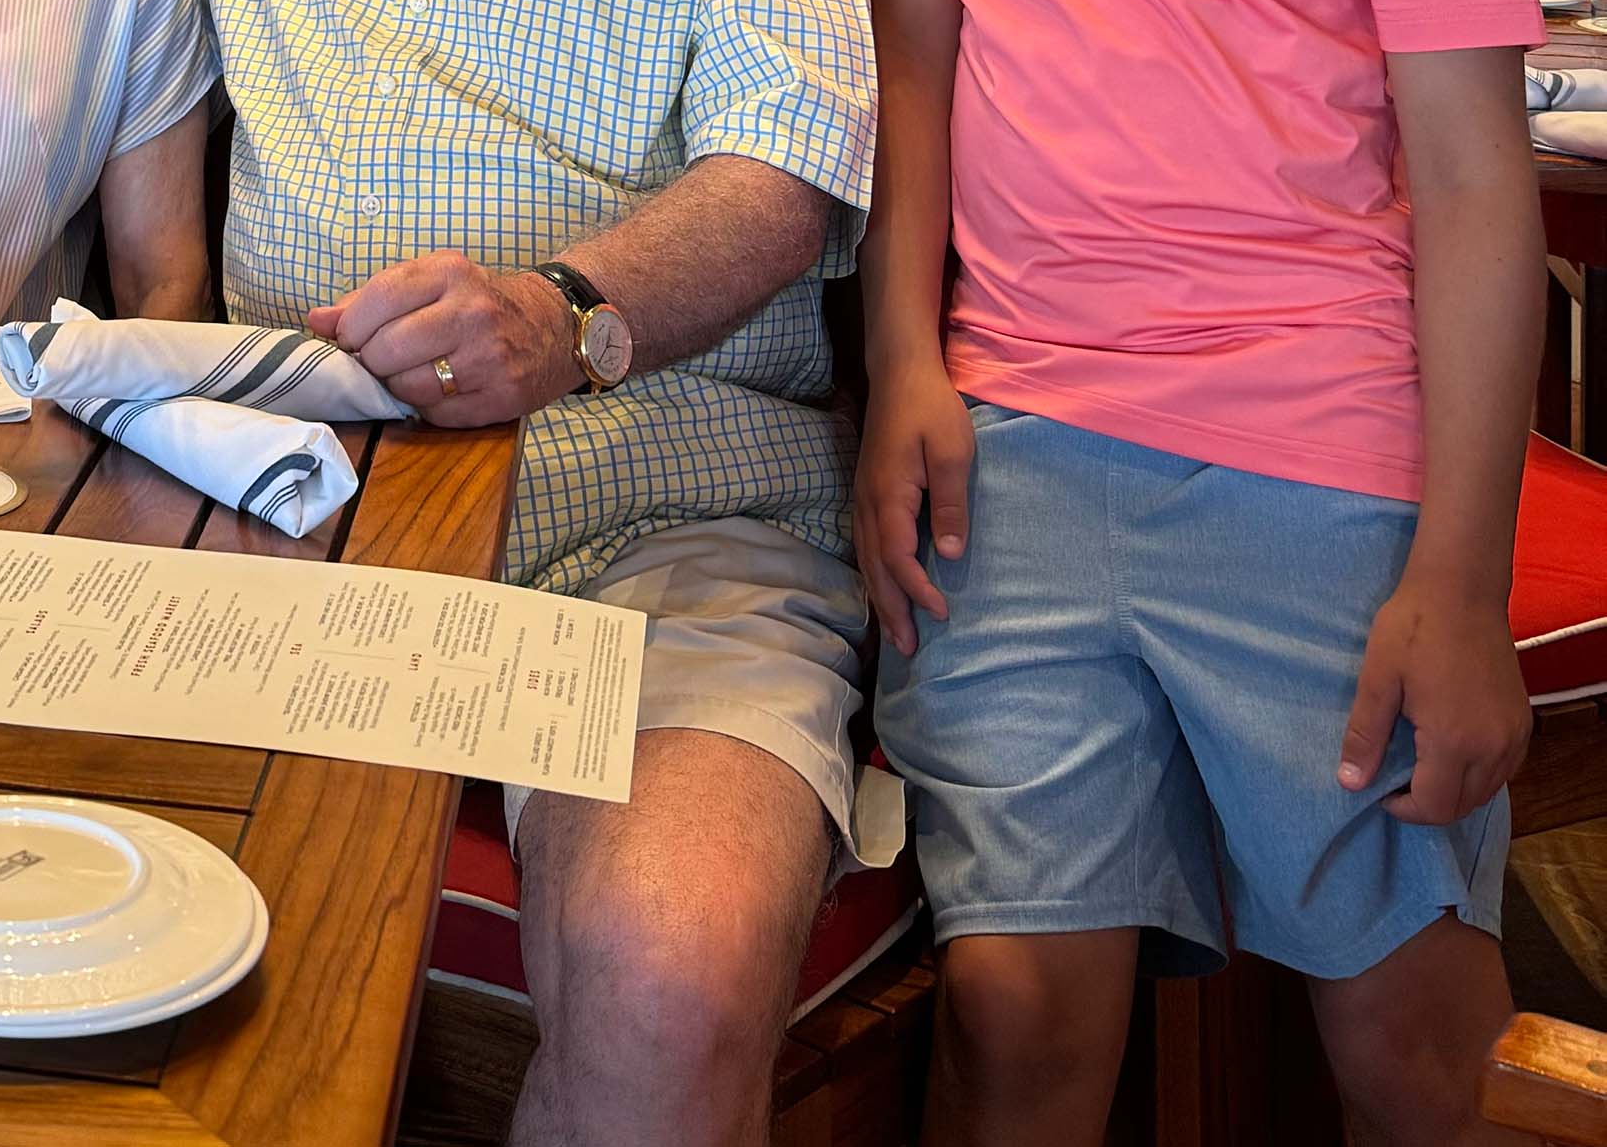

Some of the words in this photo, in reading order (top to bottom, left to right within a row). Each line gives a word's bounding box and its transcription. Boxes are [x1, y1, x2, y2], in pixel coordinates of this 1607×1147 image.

[25, 610, 48, 634] SALADS
[130, 654, 150, 676] FRESH
[142, 622, 167, 653] SEAFOOD
[160, 596, 181, 620] MARKET
[289, 643, 303, 655] SEA
[408, 653, 422, 671] LAND
[526, 670, 541, 690] SIDES
